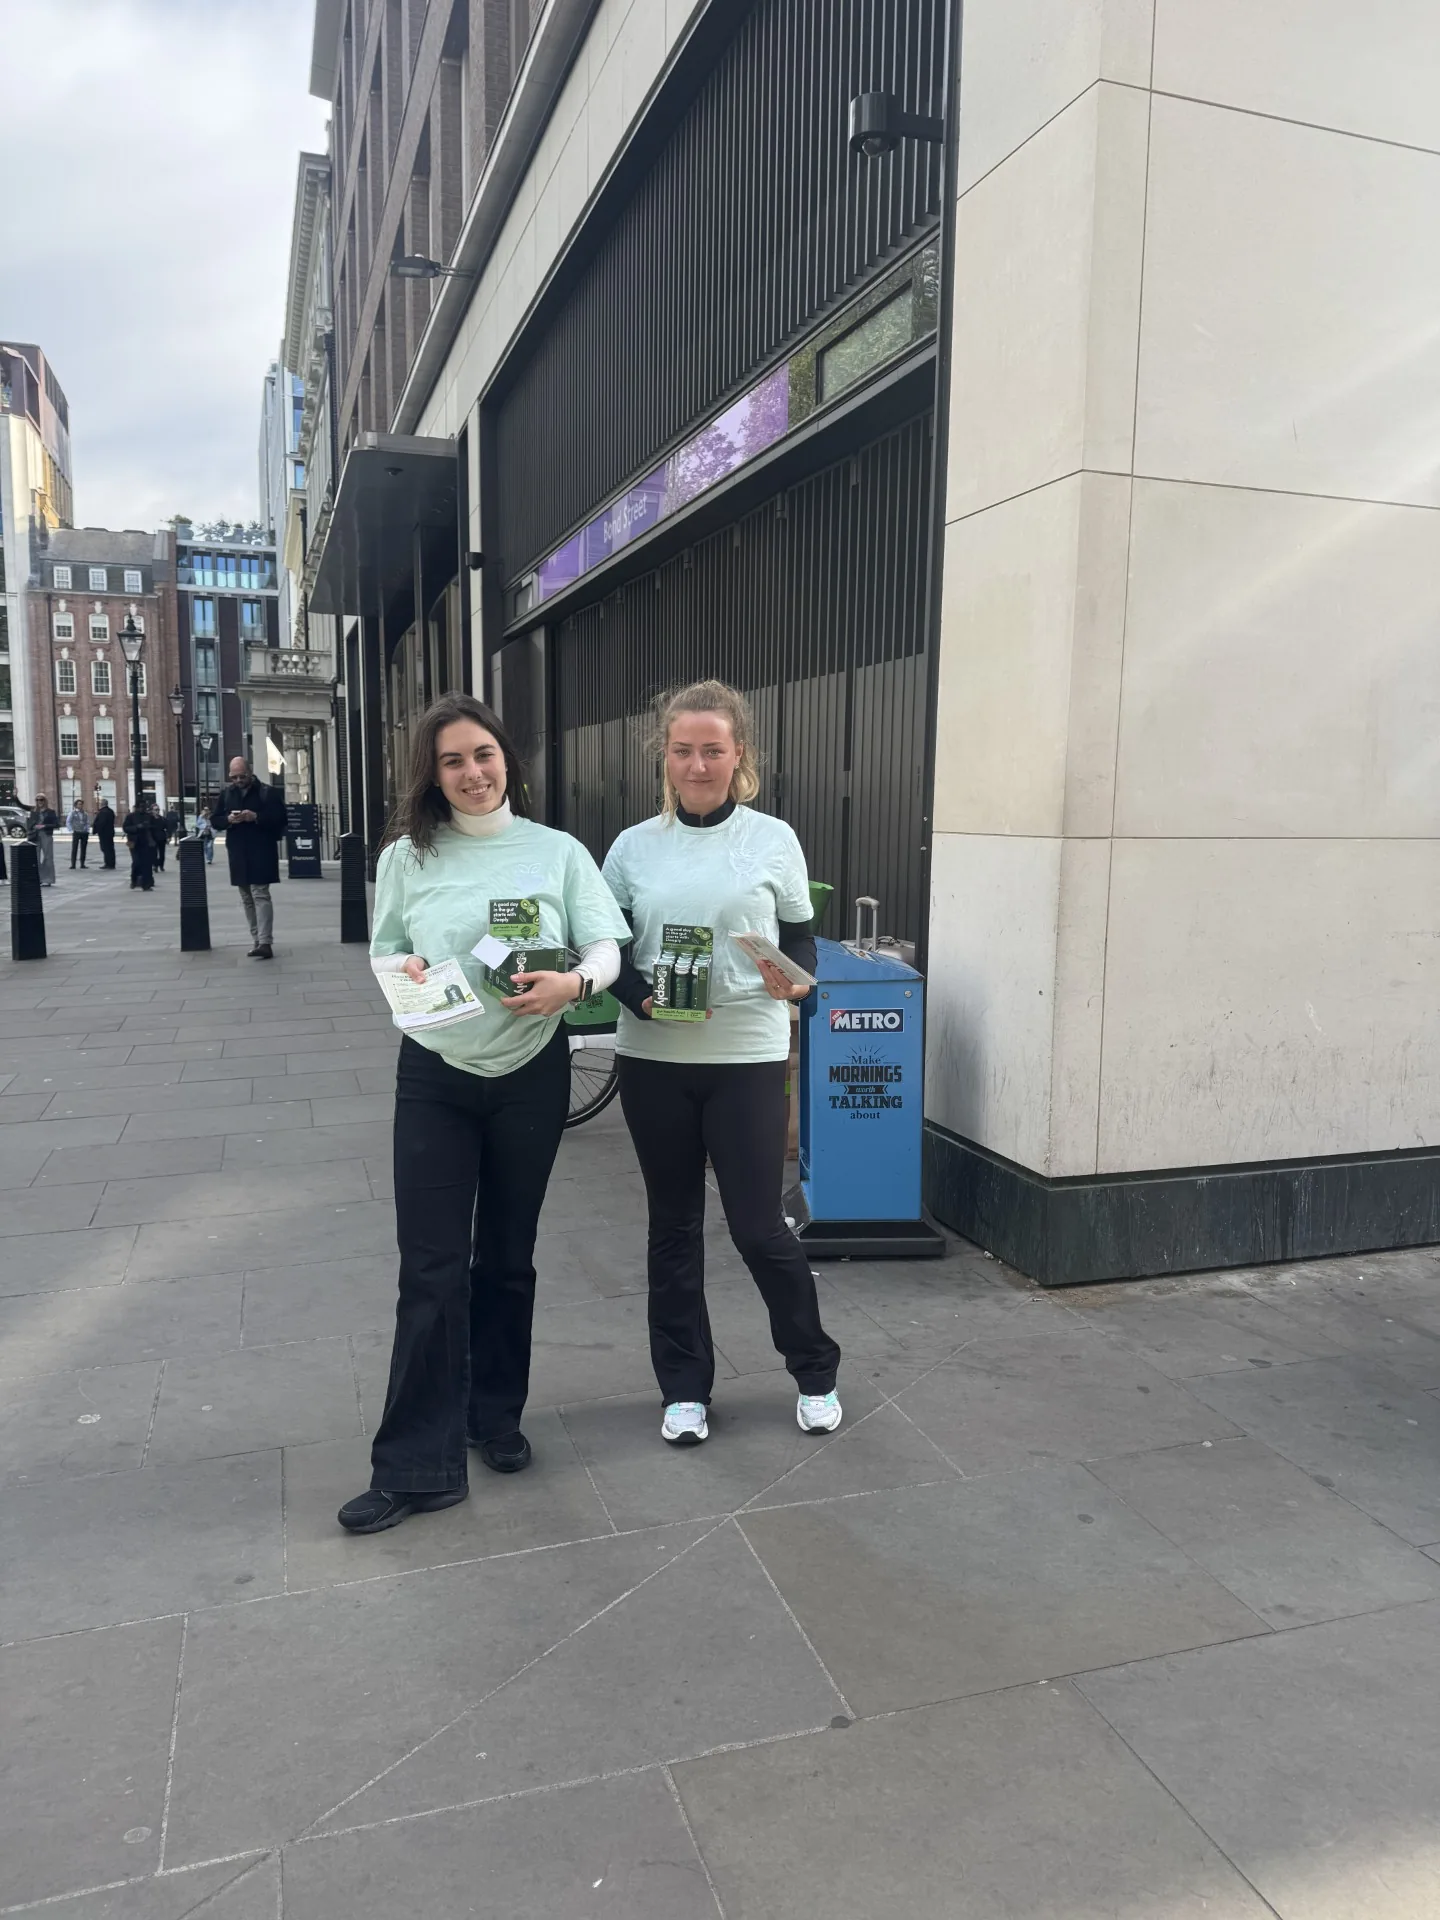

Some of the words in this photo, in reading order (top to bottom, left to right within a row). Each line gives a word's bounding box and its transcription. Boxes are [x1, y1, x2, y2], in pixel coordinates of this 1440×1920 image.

[604, 510, 622, 543] Bond
[623, 492, 648, 529] Street
[654, 970, 668, 1006] Deeply
[834, 1012, 900, 1029] METRO
[851, 1056, 881, 1064] Make
[828, 1066, 902, 1082] MORNINGS
[828, 1096, 902, 1109] TALKING
[850, 1110, 880, 1119] about
